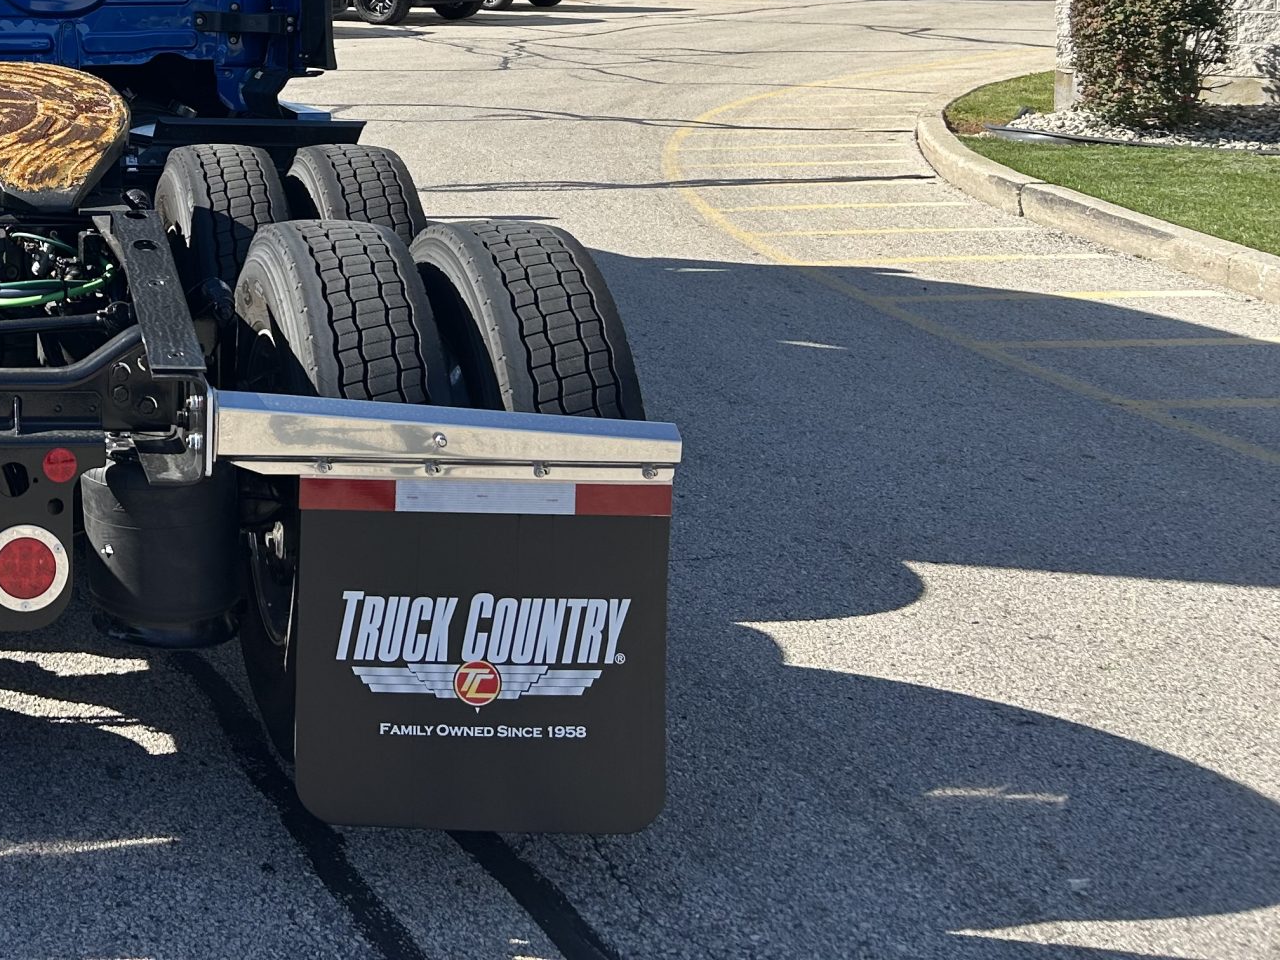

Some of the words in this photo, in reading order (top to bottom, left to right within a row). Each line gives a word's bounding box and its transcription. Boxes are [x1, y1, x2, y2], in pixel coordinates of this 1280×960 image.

[335, 590, 459, 662] TRUCK
[461, 593, 631, 665] COUNTRY
[379, 722, 435, 737] FAMILY
[436, 724, 495, 738] OWNED
[497, 725, 543, 738] SINCE
[547, 725, 587, 739] 1958
